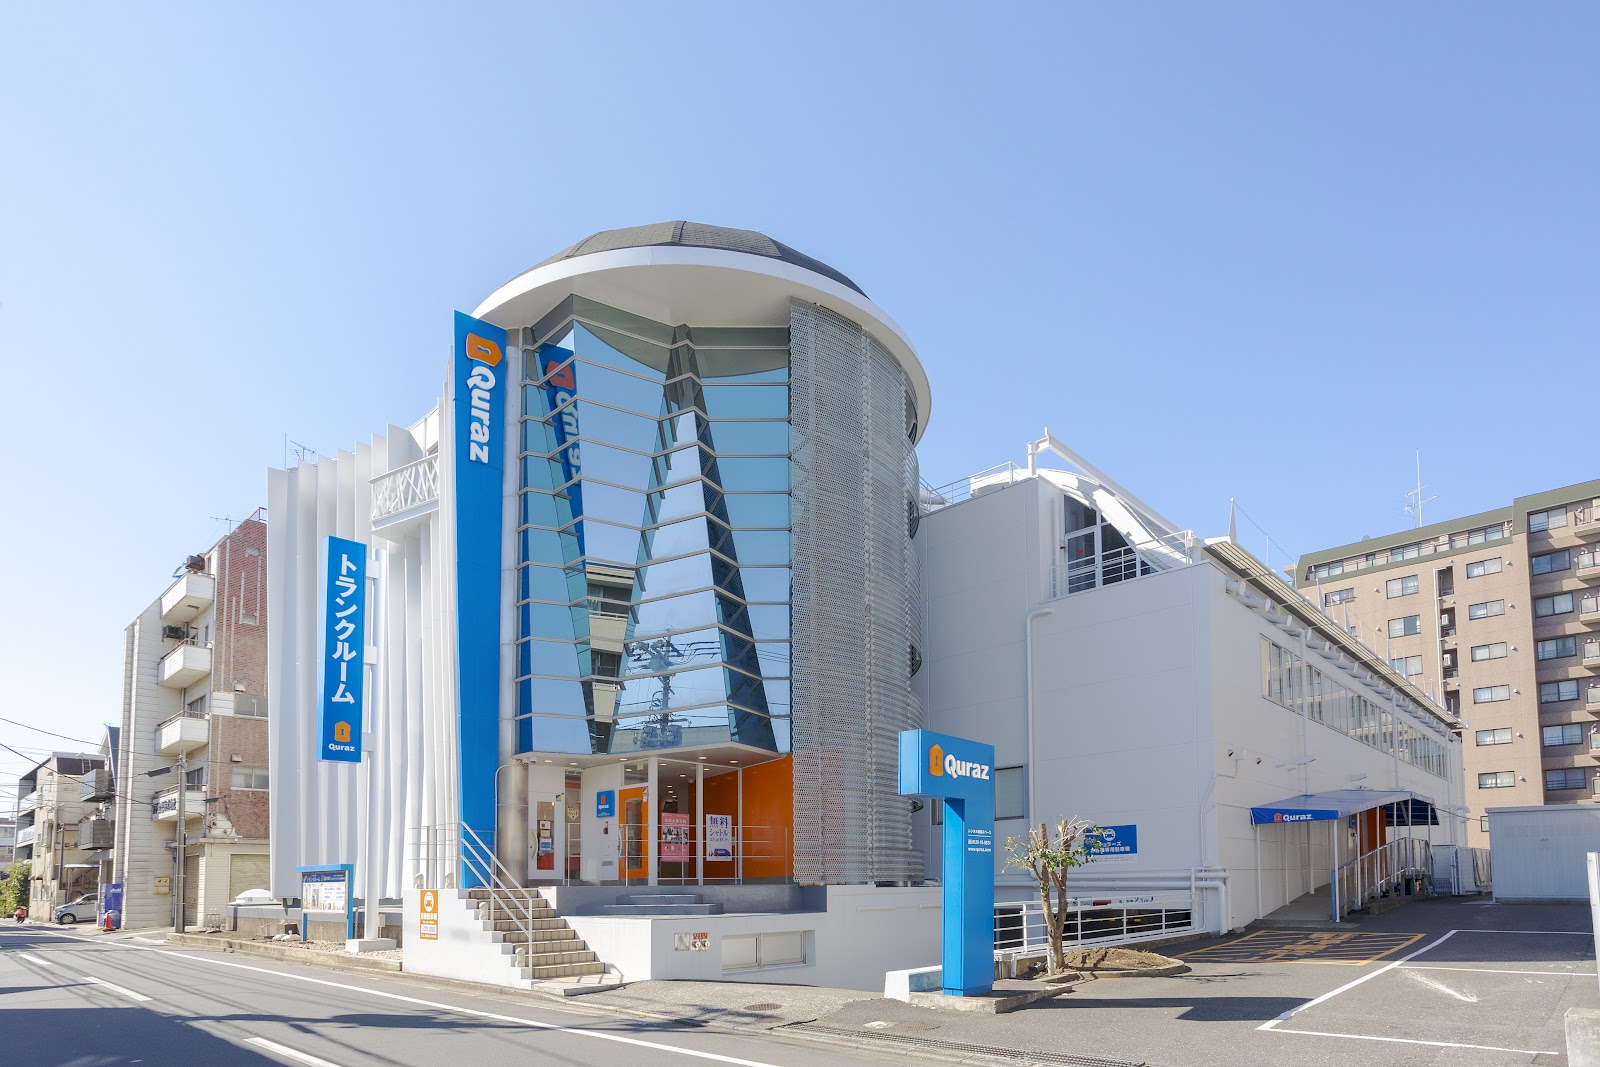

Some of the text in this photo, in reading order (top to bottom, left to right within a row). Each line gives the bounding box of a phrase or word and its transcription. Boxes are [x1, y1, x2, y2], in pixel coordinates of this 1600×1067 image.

[466, 366, 496, 464] Quraz
[331, 553, 358, 705] トランクルーム
[328, 743, 356, 752] Quraz
[944, 754, 990, 780] Quraz
[1283, 814, 1313, 822] Quraz
